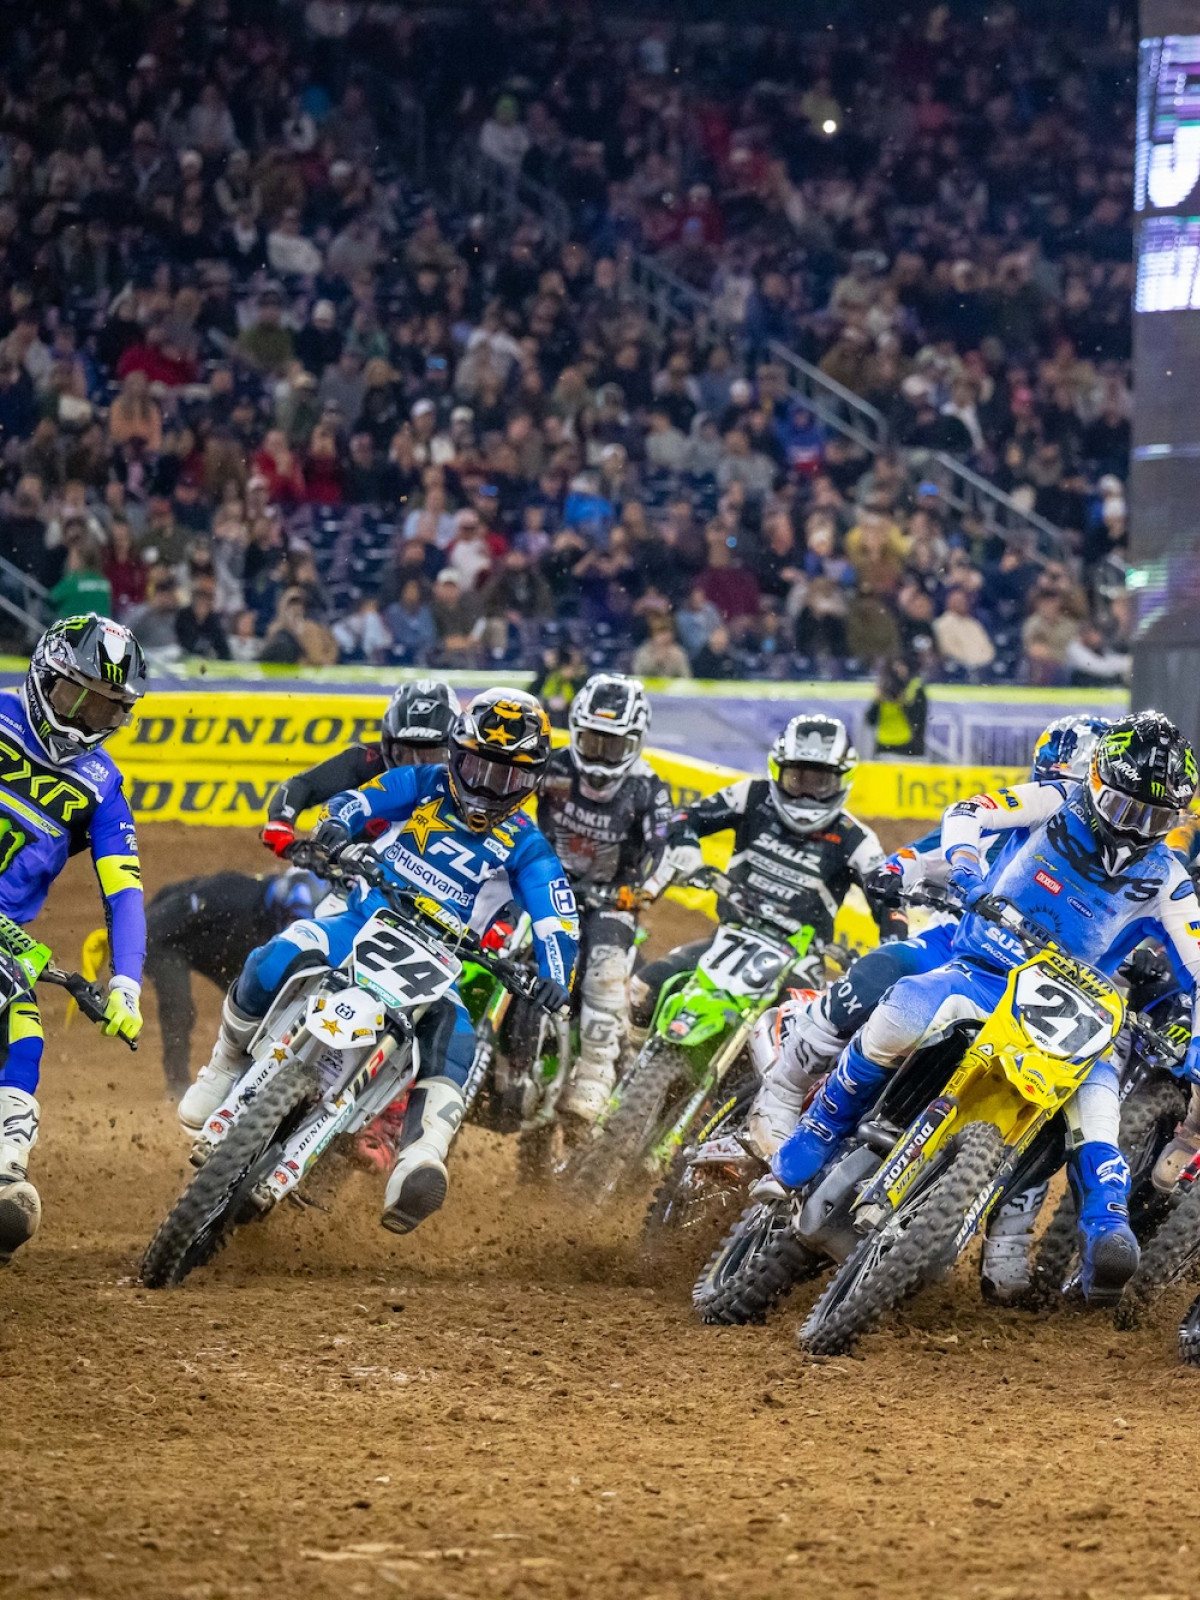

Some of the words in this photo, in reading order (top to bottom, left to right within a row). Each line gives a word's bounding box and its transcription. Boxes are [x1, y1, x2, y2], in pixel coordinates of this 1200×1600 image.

[134, 716, 386, 746] DUNLOP
[398, 850, 472, 906] Husqvarna
[426, 836, 489, 884] FLY
[752, 832, 821, 873] SKILLZ
[356, 930, 450, 1000] 24
[706, 932, 784, 989] 719
[1021, 983, 1104, 1055] 21
